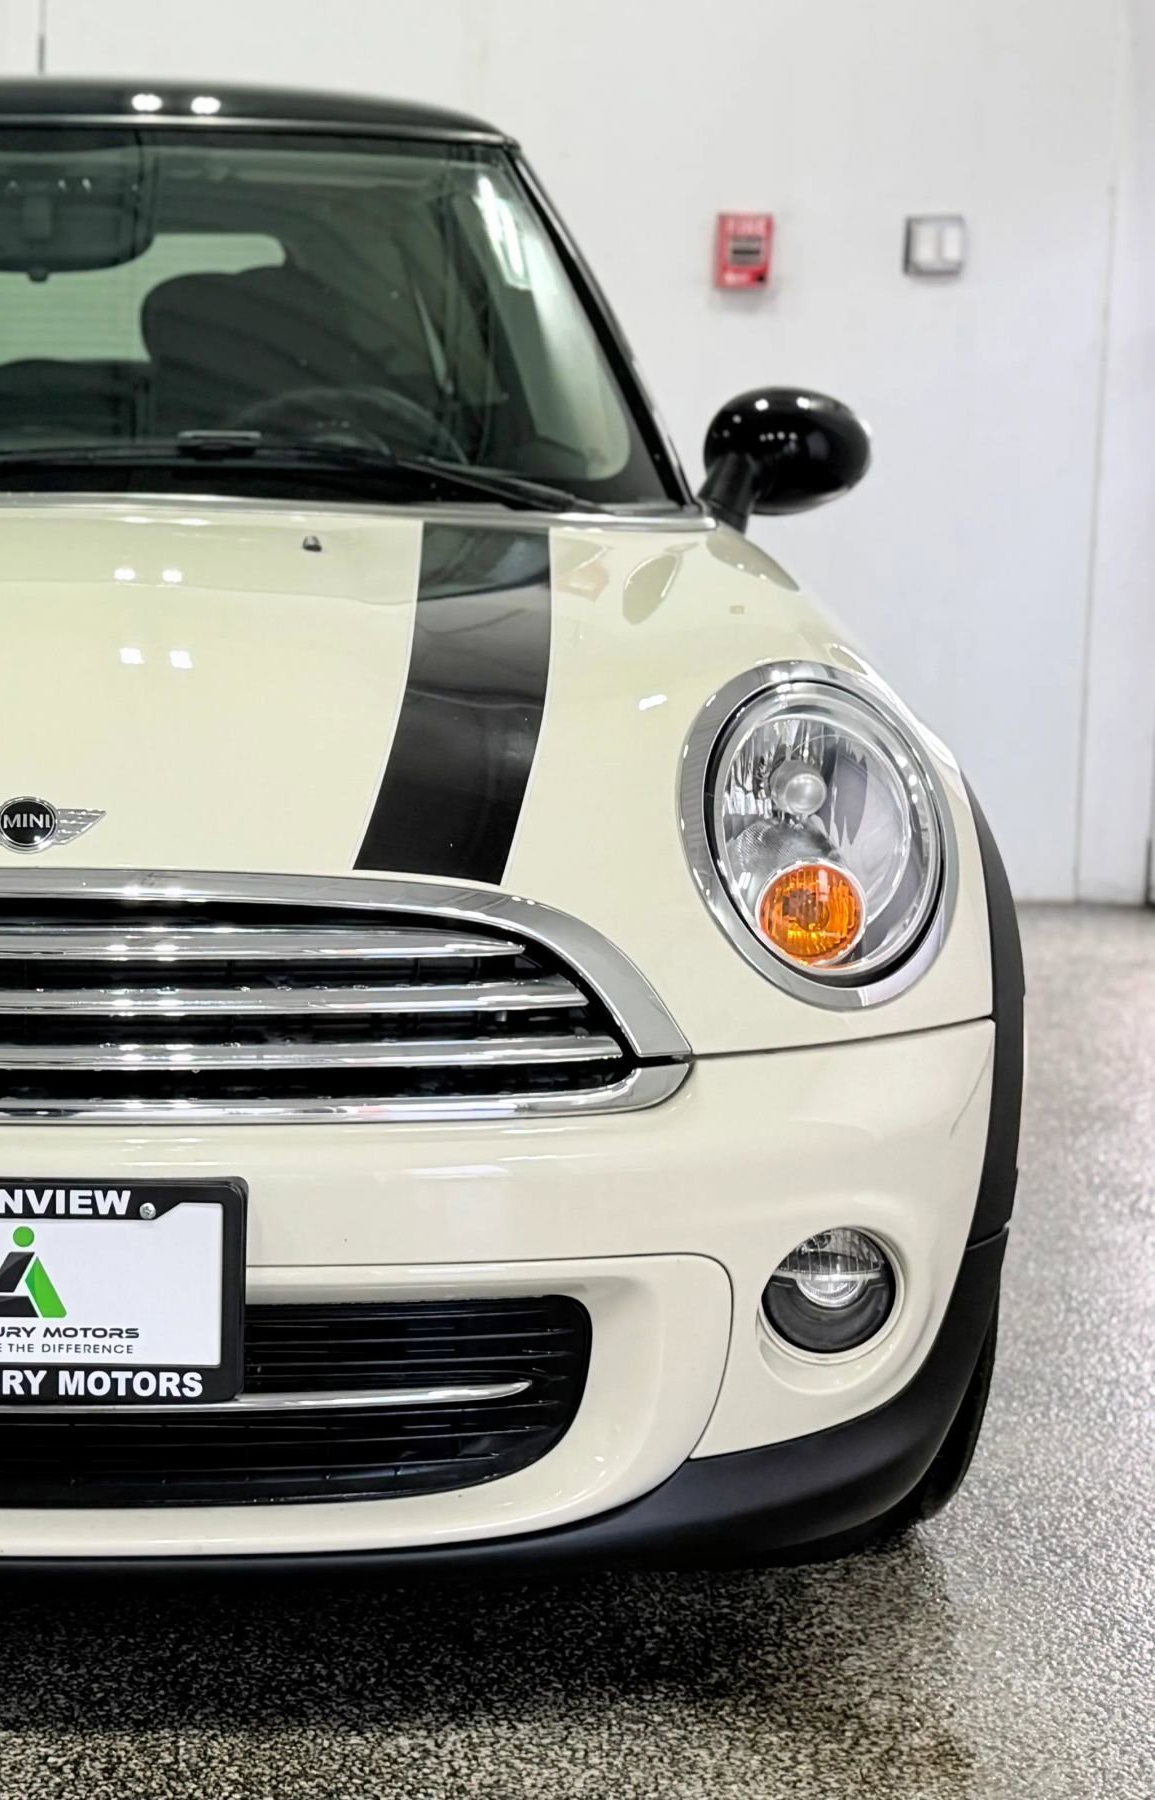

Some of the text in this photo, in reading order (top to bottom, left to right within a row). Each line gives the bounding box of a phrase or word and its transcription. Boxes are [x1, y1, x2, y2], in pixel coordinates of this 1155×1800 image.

[3, 813, 51, 829] MINI
[43, 1327, 140, 1339] MOTORS
[8, 1343, 35, 1353] THE
[42, 1343, 134, 1354] DIFFERENCE
[58, 1370, 203, 1397] MOTORS
